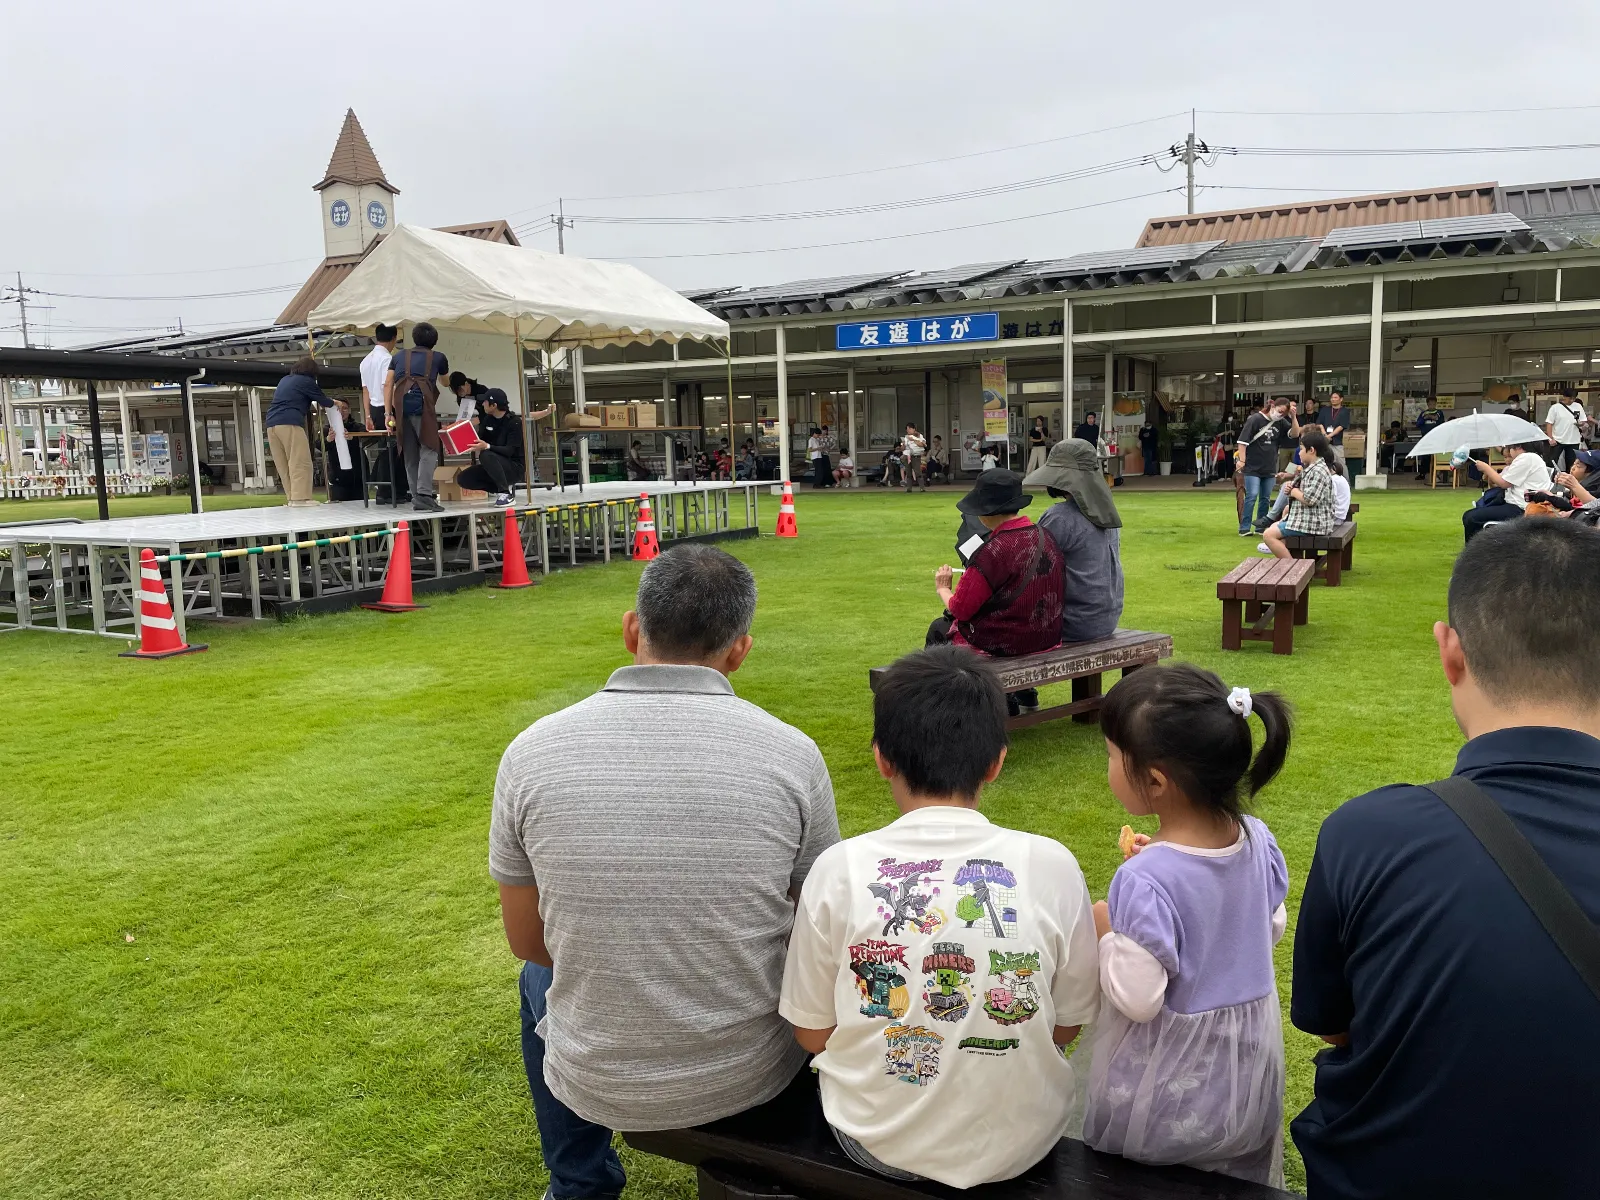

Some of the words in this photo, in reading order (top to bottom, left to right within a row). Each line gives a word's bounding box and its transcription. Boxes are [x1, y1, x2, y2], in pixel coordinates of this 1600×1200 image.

[333, 211, 349, 223] はが
[370, 213, 386, 225] はが
[859, 317, 971, 346] 友遊はが
[1244, 371, 1297, 386] 物産館
[932, 942, 965, 955] TEAM
[848, 945, 911, 972] REDSTONE
[922, 954, 976, 975] MINERS
[958, 1037, 1020, 1050] MINECRAFT
